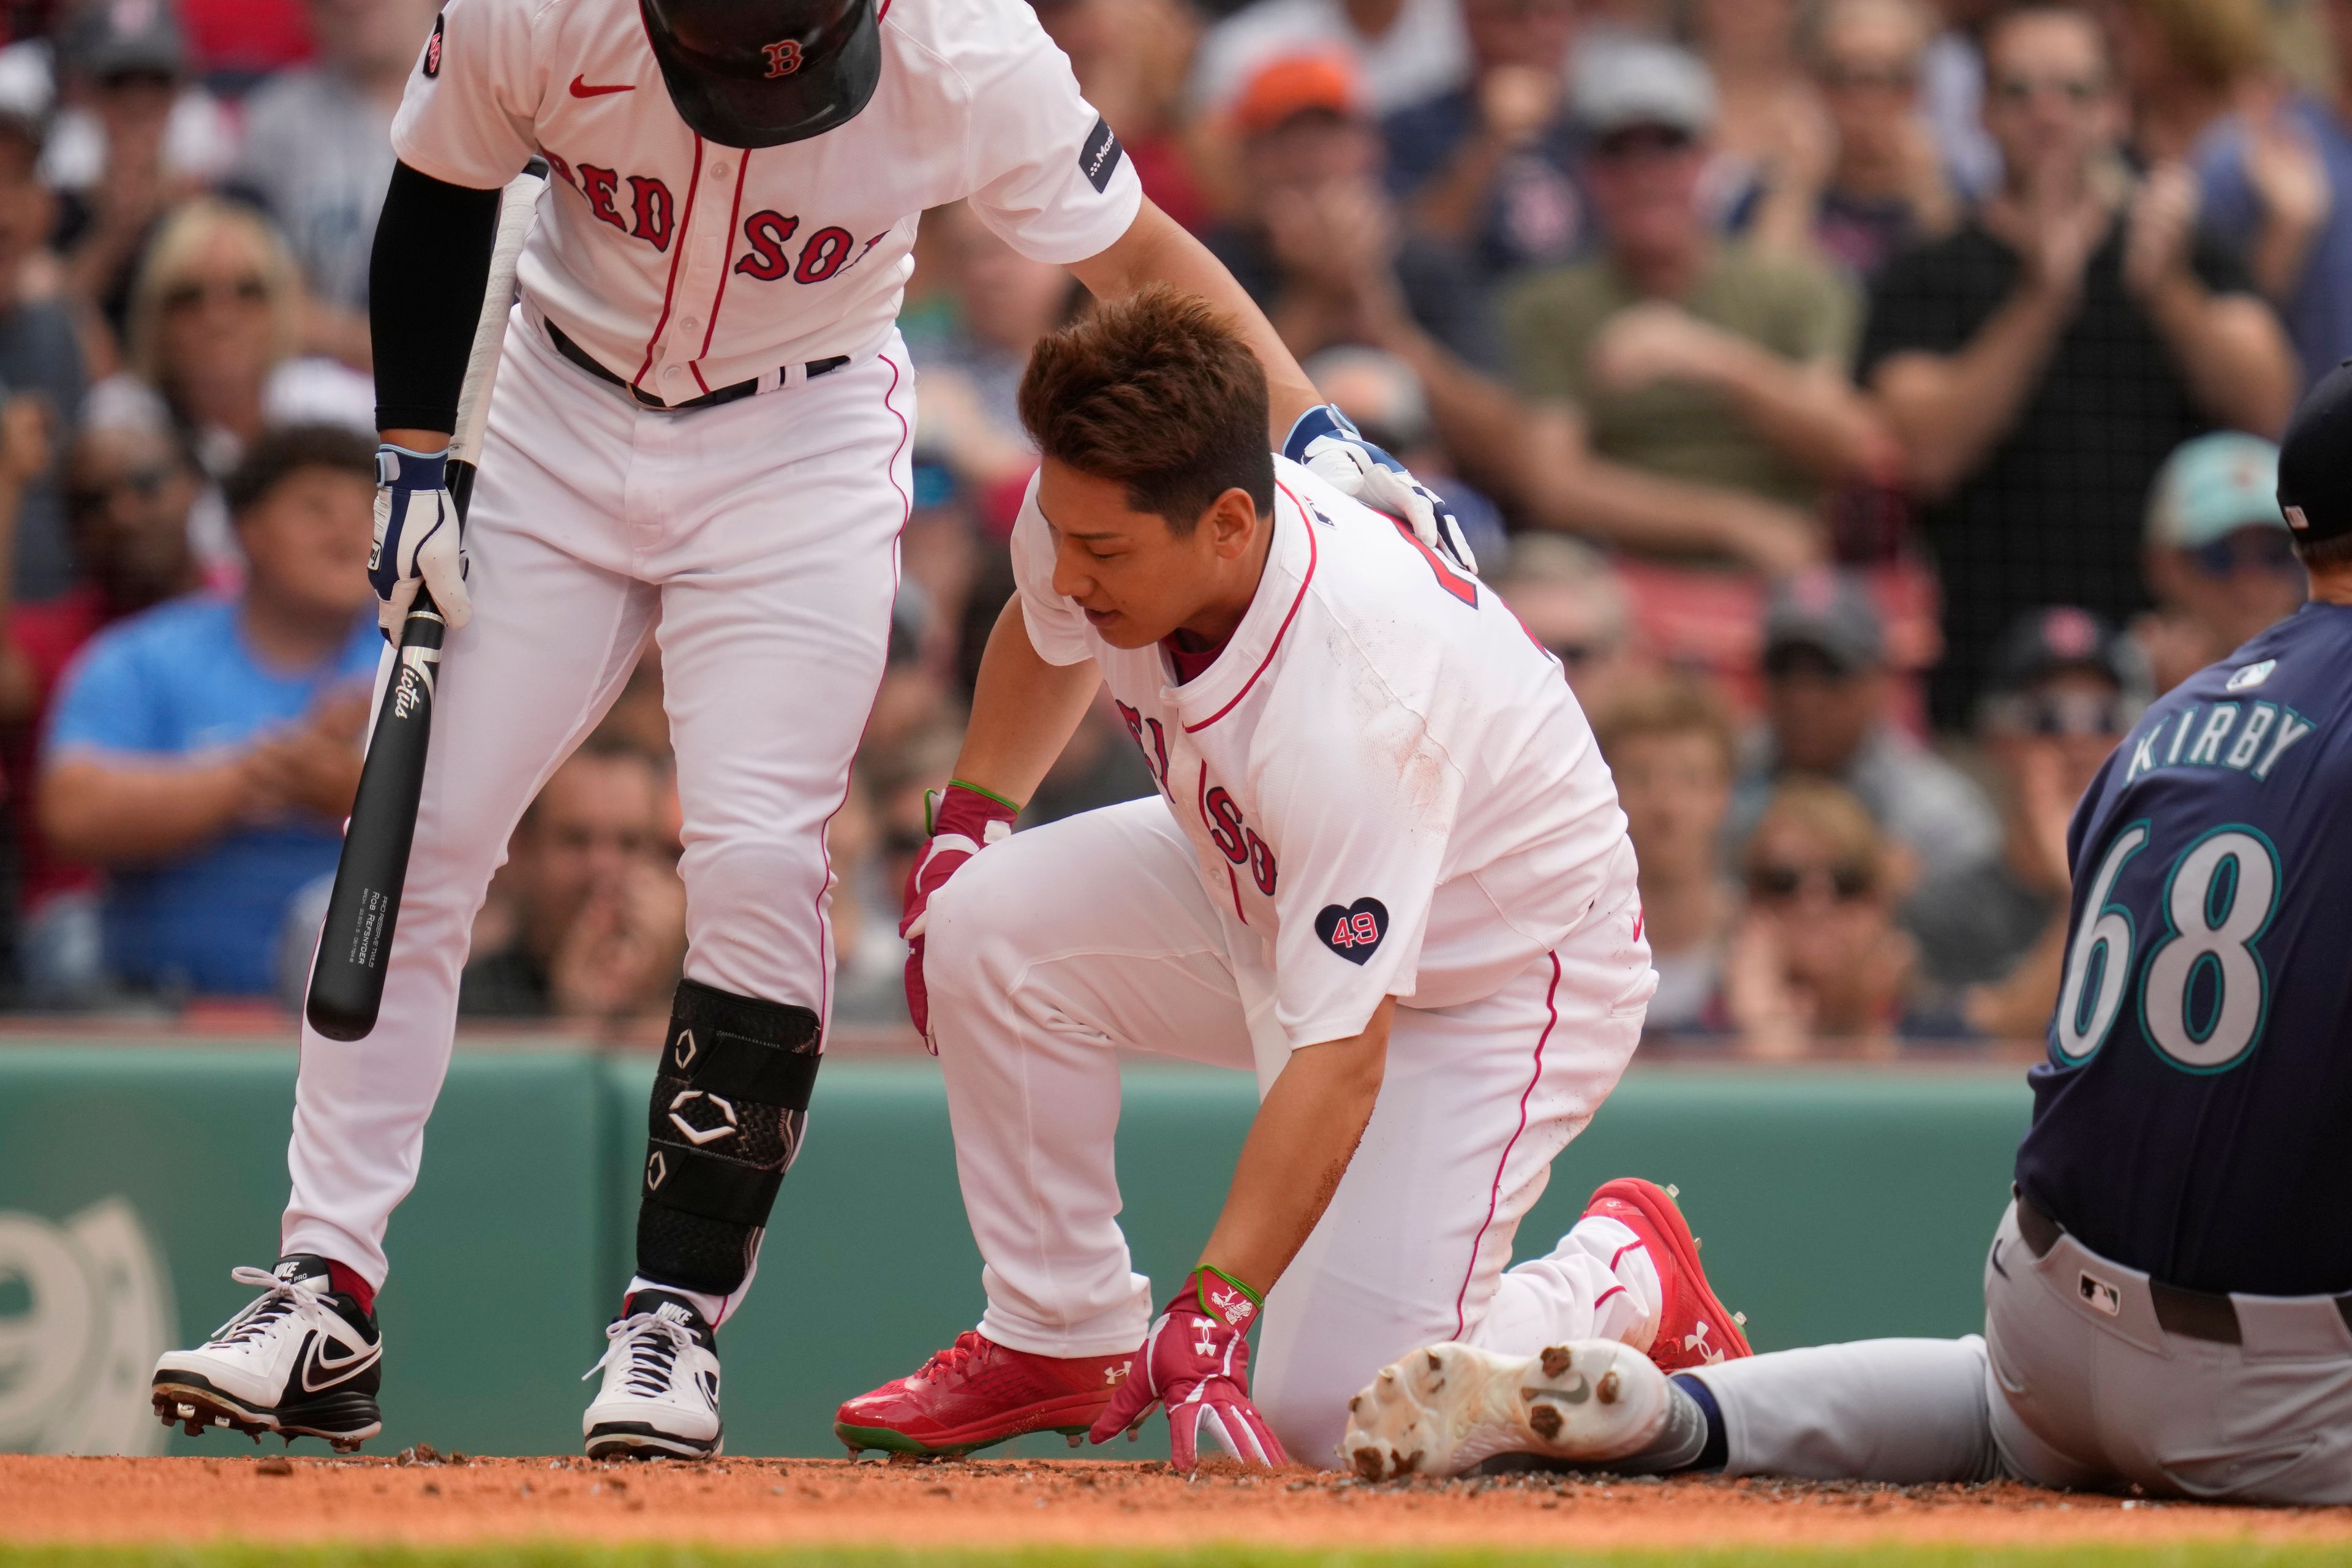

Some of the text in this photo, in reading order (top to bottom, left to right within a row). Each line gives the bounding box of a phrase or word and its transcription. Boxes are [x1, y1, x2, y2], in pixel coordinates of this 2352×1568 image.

[761, 40, 804, 78] B
[734, 209, 891, 284] SO
[2122, 700, 2316, 788] KIRBY
[1206, 786, 1278, 896] SO
[372, 913, 384, 946] RESERVE
[1332, 912, 1378, 948] 49
[2056, 818, 2282, 1076] 68
[273, 1262, 300, 1278] NIKE
[294, 1273, 307, 1282] PRO
[655, 1302, 693, 1327] NIKE
